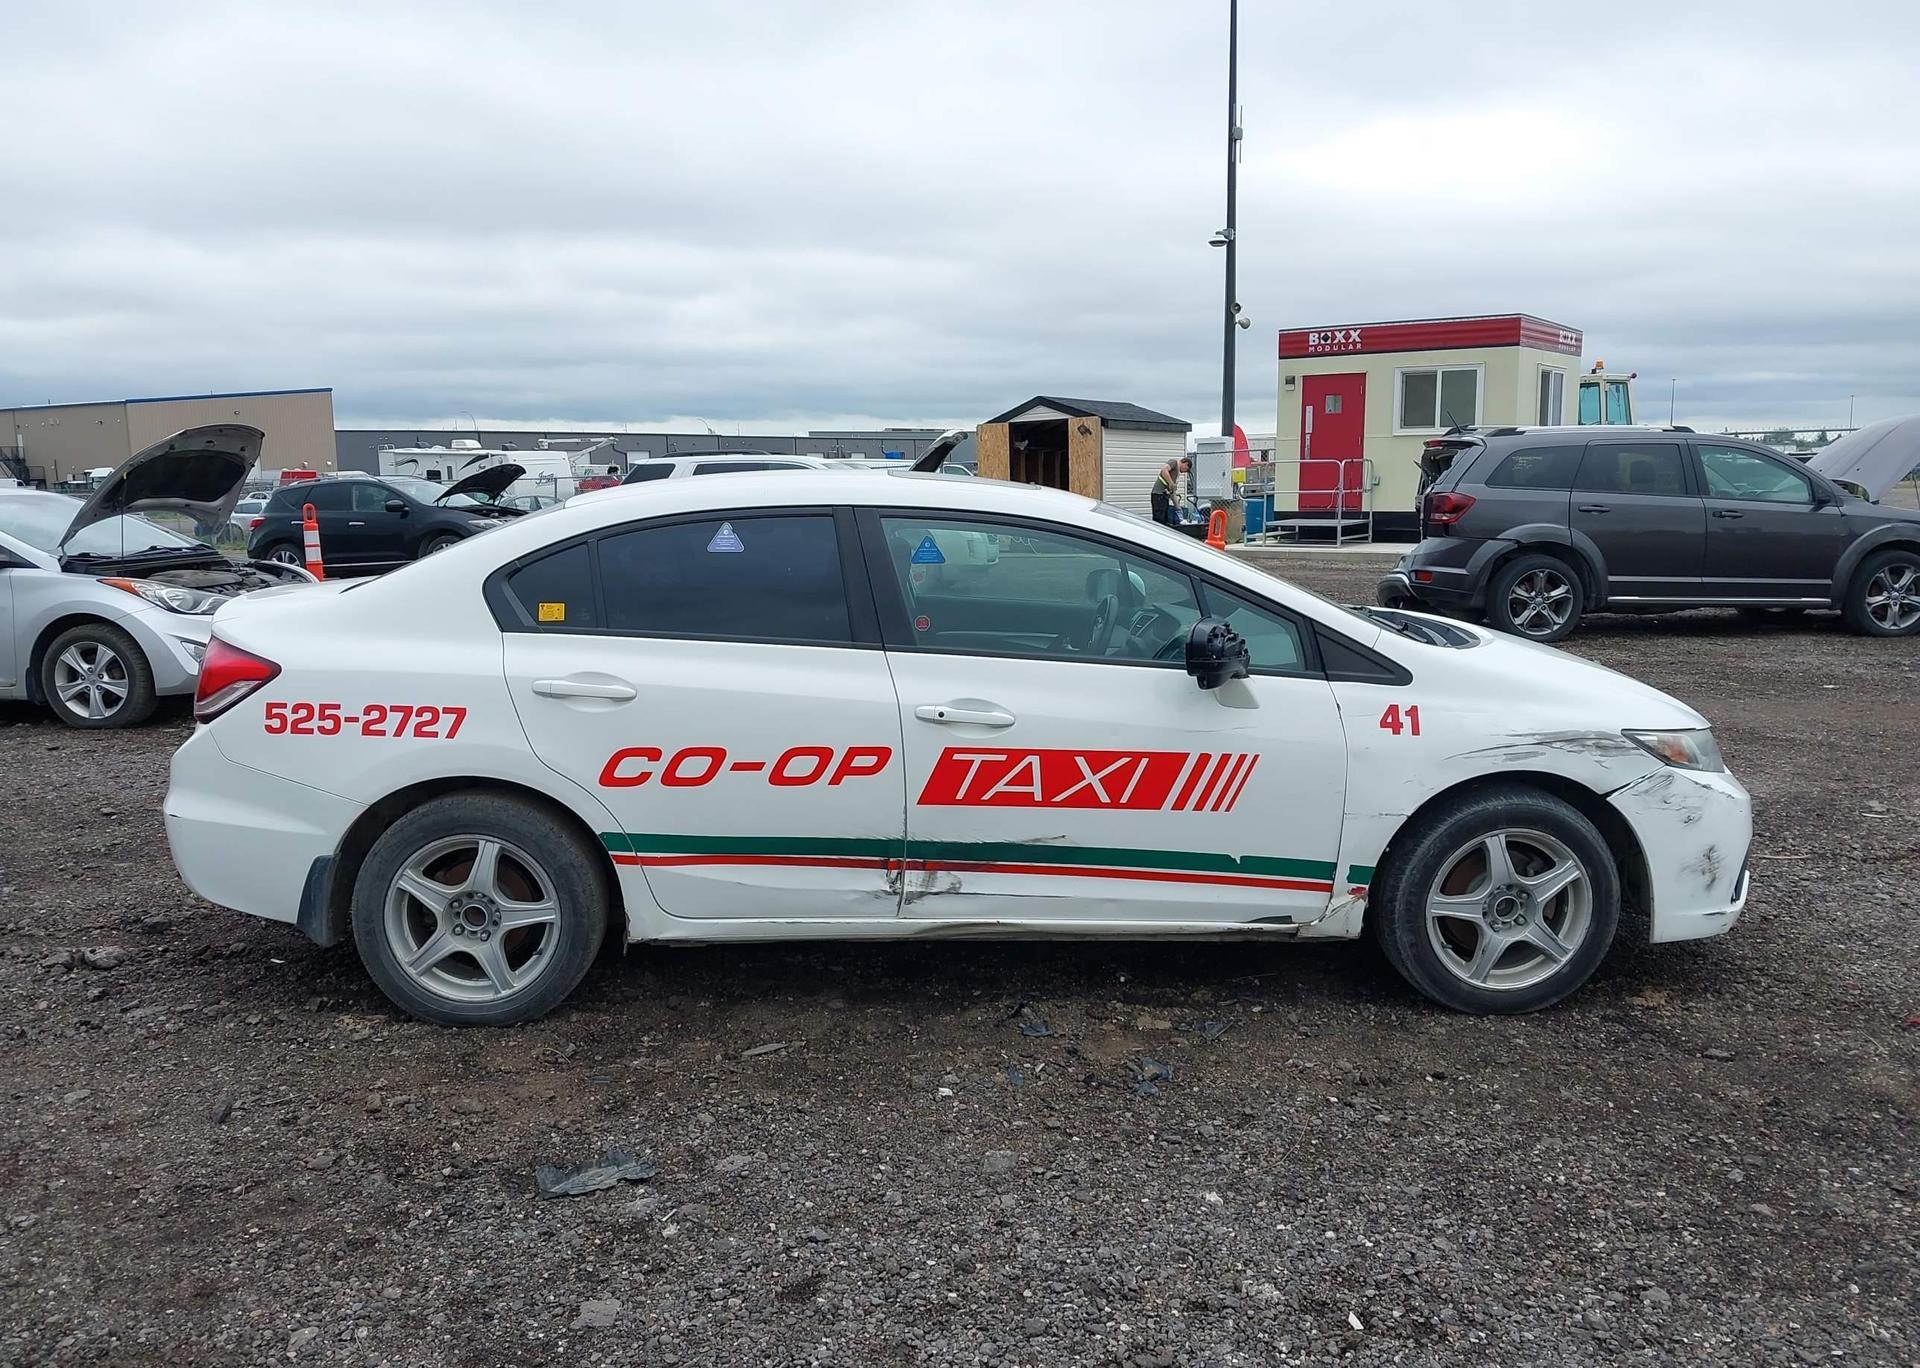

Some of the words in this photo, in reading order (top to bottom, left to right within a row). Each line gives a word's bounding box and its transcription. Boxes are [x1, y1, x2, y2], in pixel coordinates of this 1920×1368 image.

[1308, 328, 1362, 346] BOXX
[1308, 343, 1362, 353] MODULAR
[264, 701, 468, 740] 525-2727
[1379, 703, 1420, 736] 41
[598, 745, 893, 788] CO-OP
[951, 753, 1150, 804] TAXI
